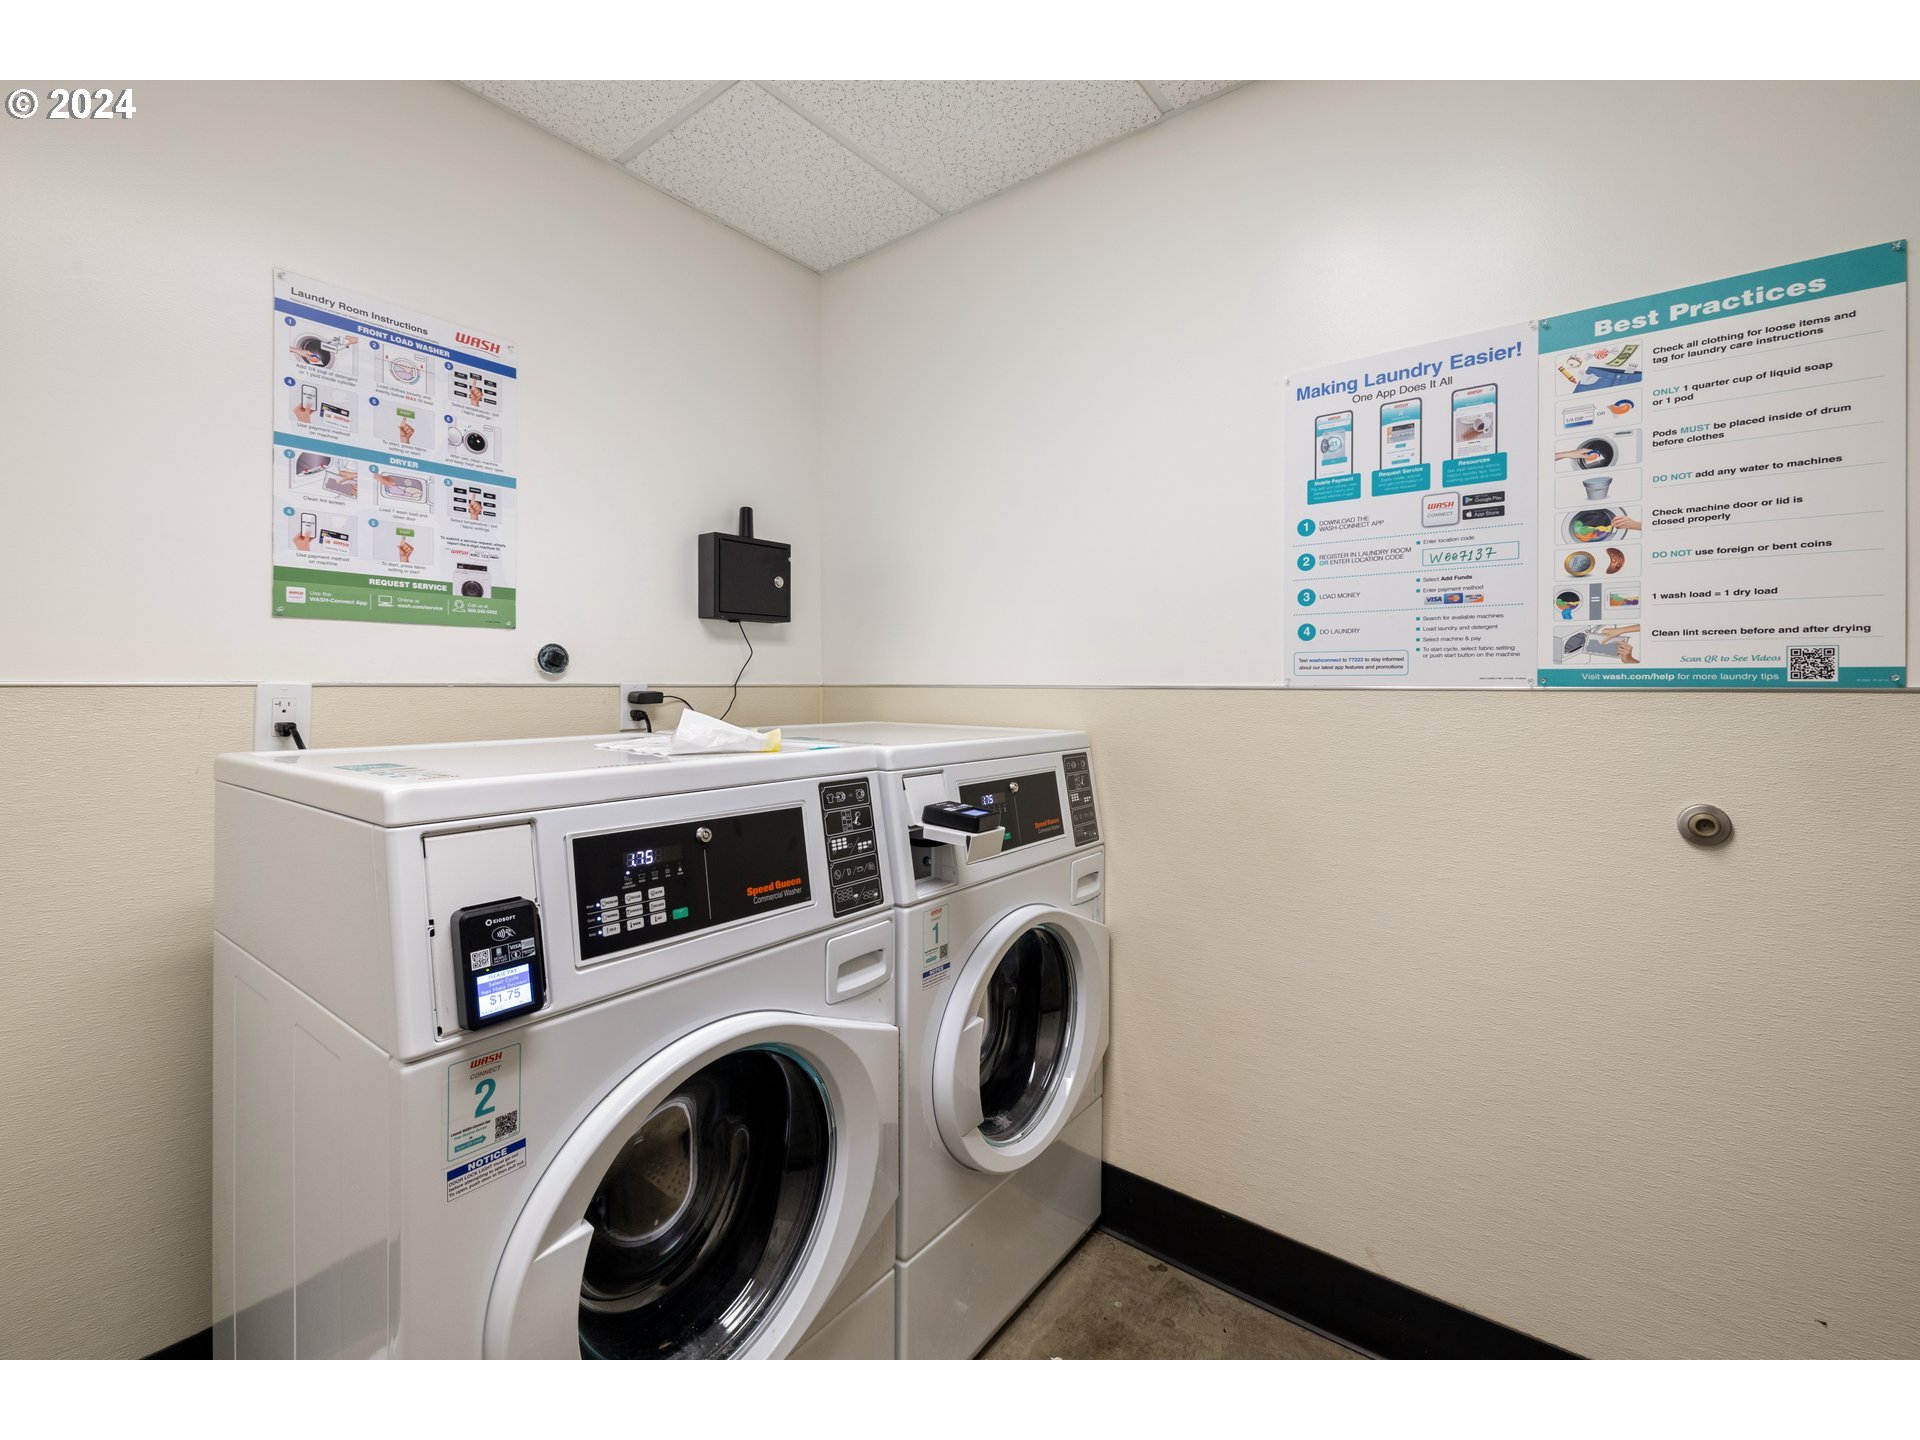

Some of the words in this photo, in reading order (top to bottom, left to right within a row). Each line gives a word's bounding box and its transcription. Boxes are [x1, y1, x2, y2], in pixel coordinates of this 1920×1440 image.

[291, 287, 335, 308] Laundry
[339, 302, 368, 317] Room
[371, 312, 428, 335] Instructions
[1594, 311, 1659, 336] Best
[1669, 277, 1828, 321] Practices
[1653, 343, 1683, 354] Check
[1686, 340, 1698, 348] all
[1701, 333, 1743, 345] clothing
[1765, 323, 1795, 333] loose
[1799, 316, 1830, 327] items
[1834, 310, 1855, 320] and
[357, 325, 388, 339] FRONT
[390, 335, 413, 347] LOAD
[416, 342, 450, 357] WASHER
[455, 332, 500, 353] WASH
[1688, 345, 1726, 357] laundry
[1730, 341, 1752, 349] care
[1756, 328, 1823, 344] instructions
[1297, 379, 1357, 401] Making
[1365, 361, 1442, 387] Laundry
[1450, 341, 1521, 369] Easier!
[1652, 386, 1680, 396] ONLY
[1683, 384, 1688, 392] 1
[1692, 379, 1729, 391] quarter
[1733, 377, 1753, 386] cup
[1756, 371, 1767, 380] of
[1770, 366, 1800, 377] liquid
[1804, 362, 1832, 371] soap
[1352, 393, 1373, 403] One
[1376, 389, 1396, 399] App
[1399, 383, 1426, 394] Does
[1430, 380, 1436, 388] It
[1439, 376, 1452, 386] All
[1674, 393, 1693, 403] pod
[1653, 429, 1677, 437] Pods
[1680, 424, 1711, 434] MUST
[1729, 416, 1766, 429] placed
[1768, 411, 1803, 422] inside
[1805, 408, 1818, 417] of
[1820, 405, 1851, 414] drum
[1653, 438, 1684, 447] before
[1686, 433, 1724, 442] clothes
[390, 457, 419, 468] DRYER
[1458, 458, 1490, 467] Resources
[1670, 472, 1693, 480] NOT
[1695, 469, 1714, 477] add
[1739, 464, 1769, 472] water
[1787, 456, 1842, 467] machines
[1428, 501, 1454, 510] WASH
[1652, 508, 1682, 516] Check
[1686, 504, 1730, 513] machine
[1319, 517, 1355, 526] DOWNLOAD
[1319, 521, 1369, 532] WASH-CONNECT
[1652, 516, 1684, 525] closed
[1688, 513, 1730, 524] properly
[1319, 552, 1349, 561] REGISTER
[1358, 549, 1389, 557] LAUNDRY
[1670, 549, 1692, 557] NOT
[1772, 542, 1797, 550] bent
[1800, 540, 1832, 548] coins
[1351, 556, 1384, 564] LOCATION
[369, 578, 410, 588] REQUEST
[412, 582, 447, 591] SERVICE
[310, 596, 355, 605] WASH-Connect
[1832, 624, 1871, 633] drying
[1704, 655, 1717, 663] QR
[1602, 673, 1674, 681] wash.com/help
[1720, 673, 1759, 681] laundry
[746, 882, 774, 897] Speed
[775, 877, 801, 889] Queen
[753, 890, 783, 905] Commercial
[784, 887, 802, 897] Washer
[493, 914, 516, 924] KIOSOFT
[933, 922, 939, 944] 1
[490, 988, 521, 1006] $1.75
[470, 1052, 503, 1069] WASH
[470, 1065, 502, 1080] CONNECT
[475, 1078, 496, 1118] 2
[468, 1148, 507, 1171] NOTICE
